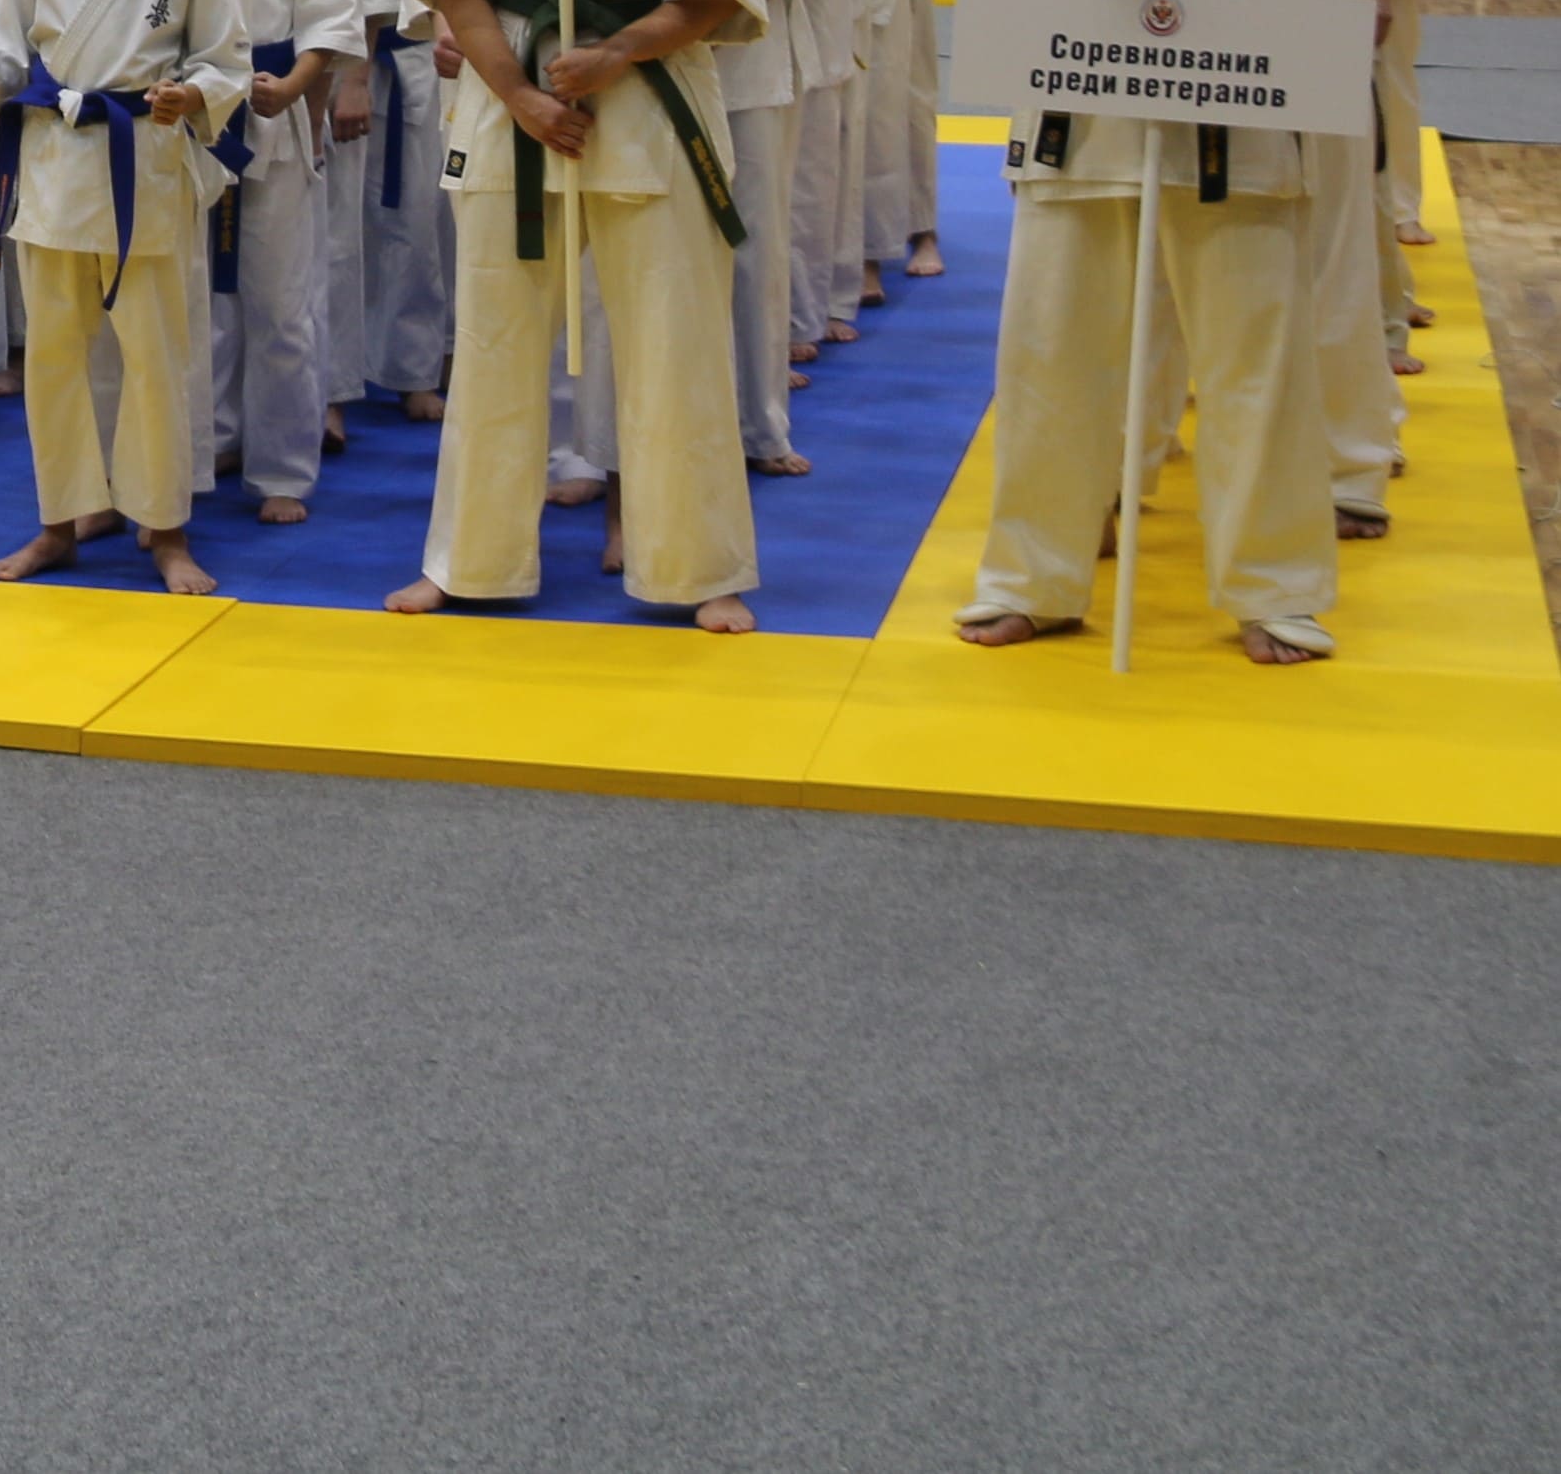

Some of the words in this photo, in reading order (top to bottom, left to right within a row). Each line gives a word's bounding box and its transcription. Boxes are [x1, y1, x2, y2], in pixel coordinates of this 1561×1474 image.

[1050, 33, 1270, 75] Соревнования
[1029, 67, 1117, 97] среди
[1125, 75, 1287, 108] ветеранов
